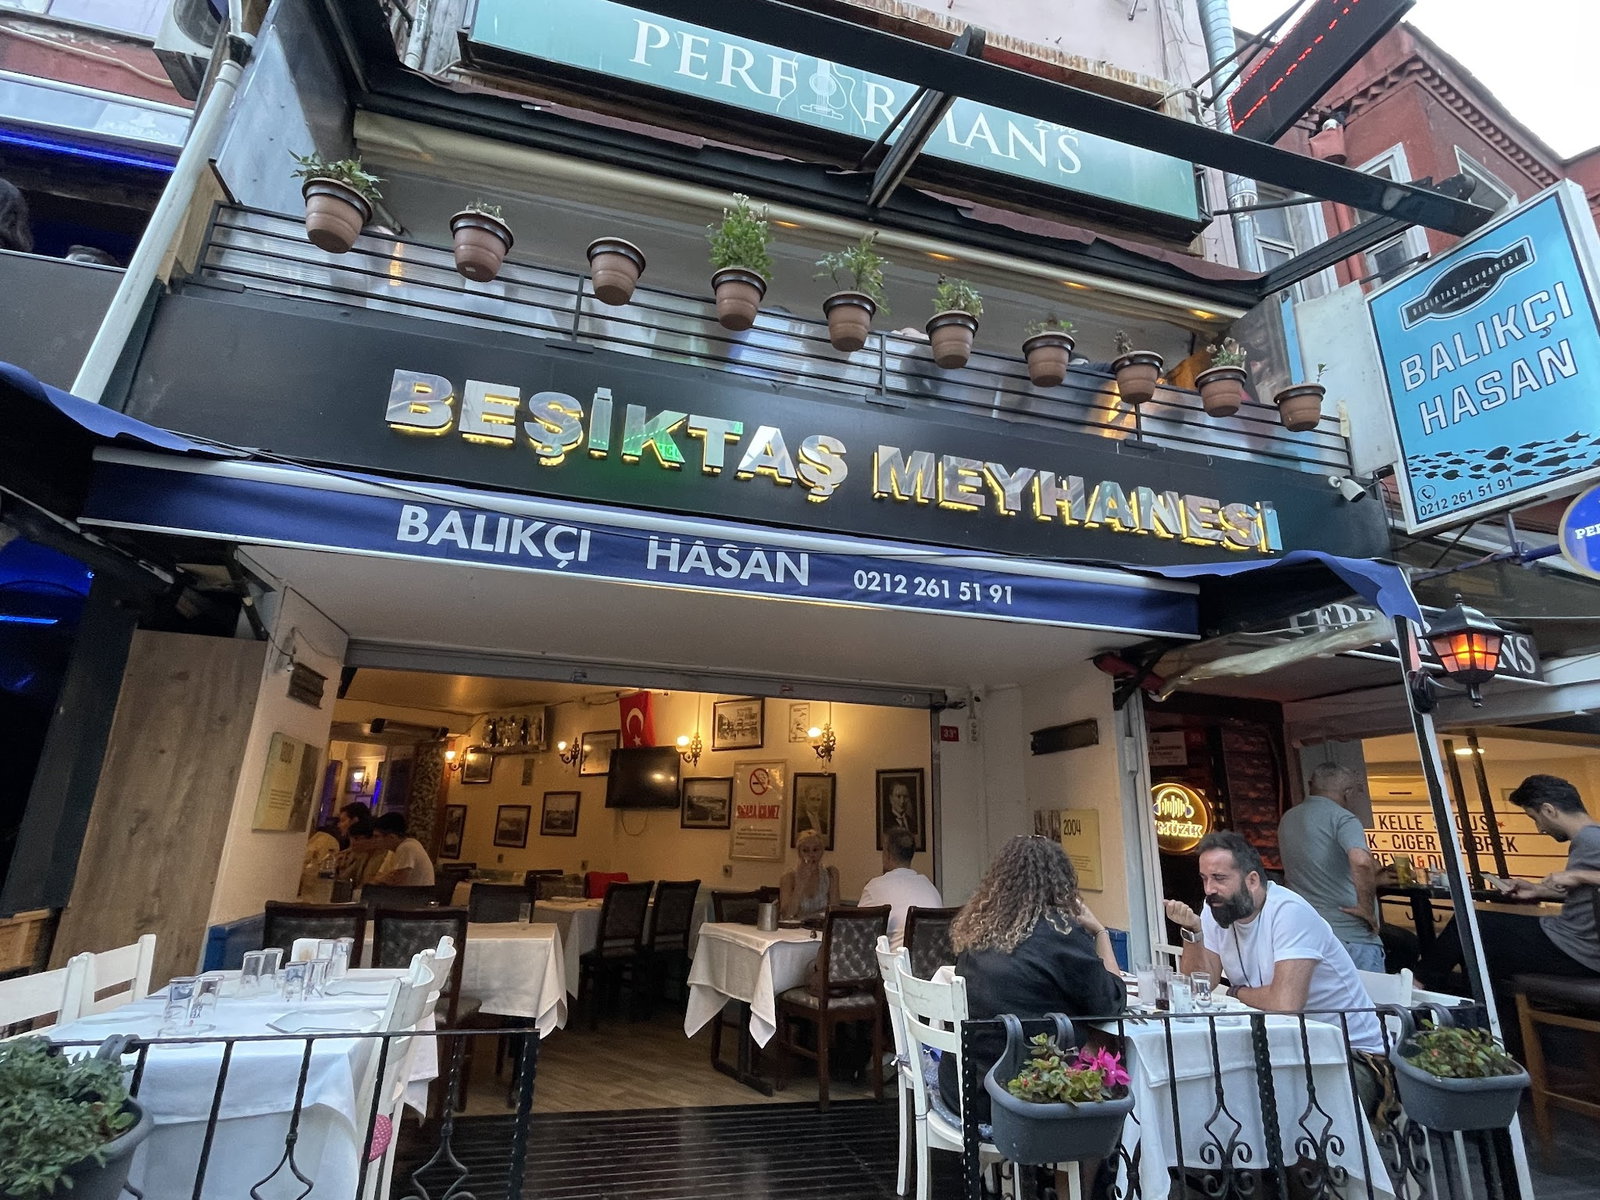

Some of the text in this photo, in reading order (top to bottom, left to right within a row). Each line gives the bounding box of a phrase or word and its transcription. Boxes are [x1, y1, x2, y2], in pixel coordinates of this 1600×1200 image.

[1400, 281, 1573, 392] BALIKÇI
[1419, 338, 1578, 435] HASAN
[385, 369, 1283, 554] BEŞİKTAŞ MEYHANESİ
[1420, 476, 1513, 516] 0212 261 51 91
[396, 504, 1013, 605] BALIKÇI HASAN 0212 261 51 91
[1063, 819, 1081, 836] 2004
[1379, 815, 1424, 831] KELLE
